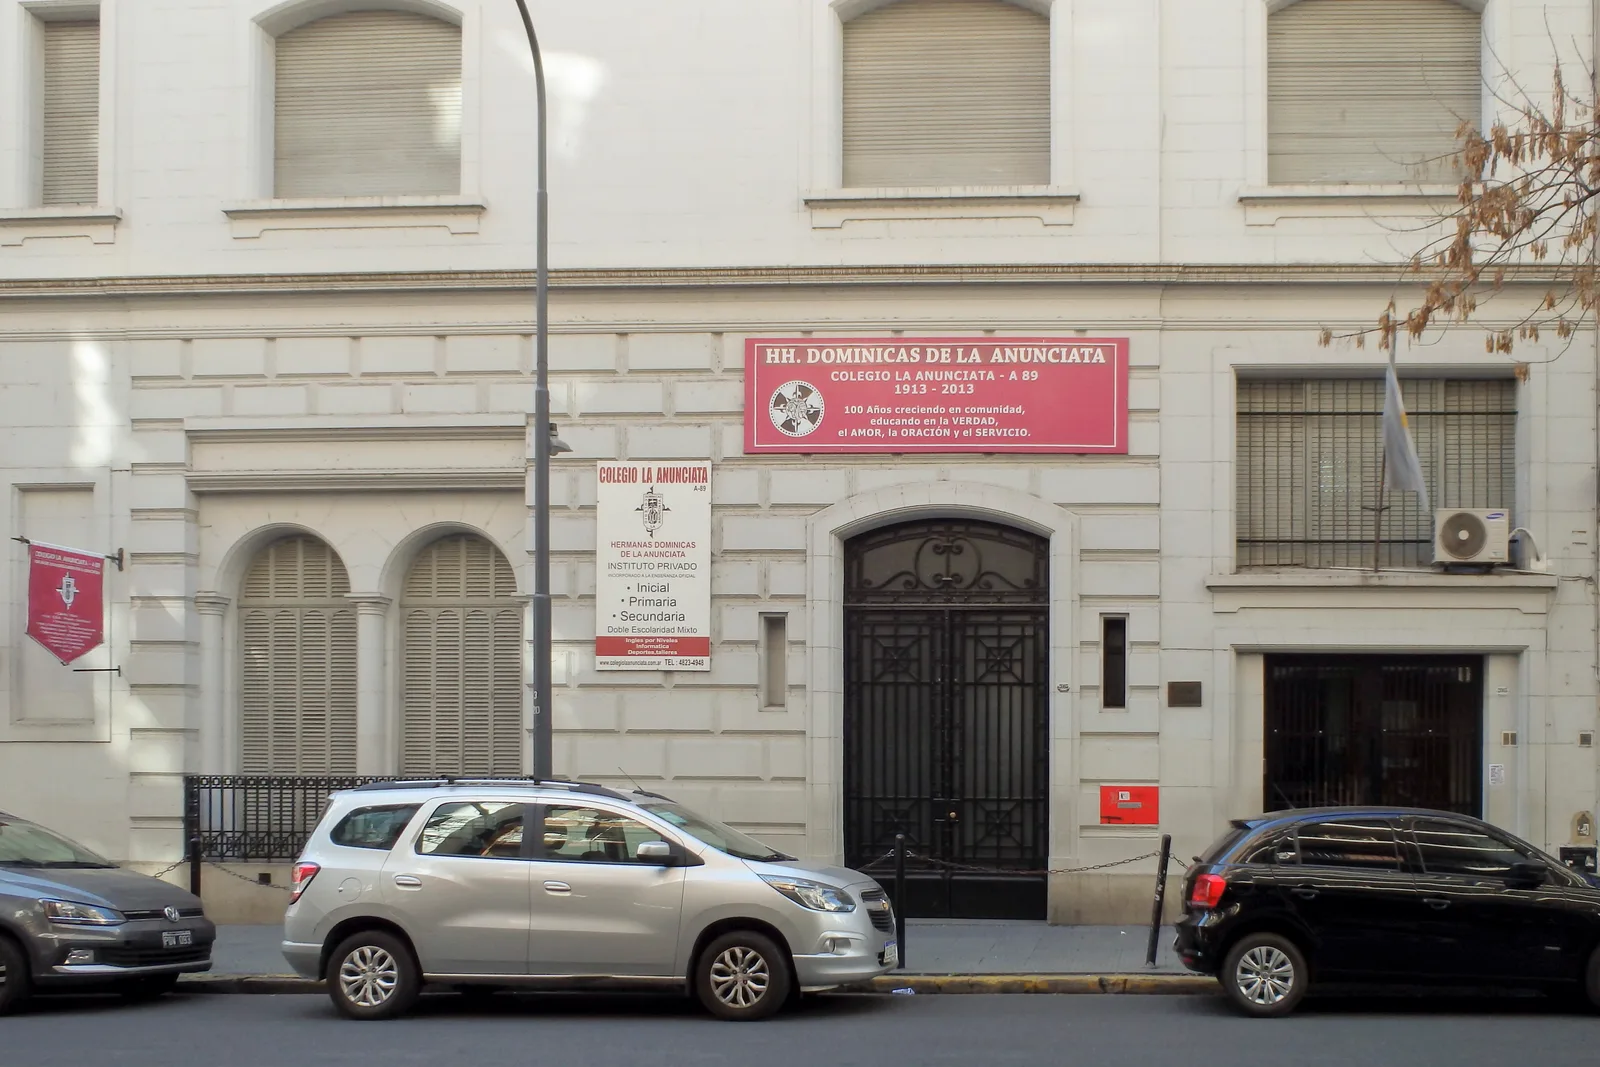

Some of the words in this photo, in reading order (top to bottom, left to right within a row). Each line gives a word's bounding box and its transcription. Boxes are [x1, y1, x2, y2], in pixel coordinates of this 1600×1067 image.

[766, 348, 801, 364] HH.
[806, 348, 920, 364] DOMINICAS
[926, 348, 951, 363] DE
[956, 348, 982, 363] LA
[990, 347, 1106, 363] ANUNCIATA
[831, 371, 891, 381] COLEGIO
[895, 371, 911, 381] LA
[915, 371, 995, 381] ANUNCIATA
[1009, 371, 1018, 381] A
[1022, 370, 1039, 381] 89
[894, 384, 927, 394] 1913
[941, 384, 974, 394] 2013
[844, 405, 864, 414] 100
[866, 405, 892, 414] Años
[895, 405, 946, 414] creciendo
[948, 406, 961, 414] en
[964, 405, 1025, 415] comunidad,
[870, 417, 920, 425] educando
[939, 417, 949, 425] la
[952, 417, 999, 426] VERDAD,
[838, 428, 848, 437] el
[850, 428, 885, 438] AMOR,
[888, 428, 898, 437] la
[901, 426, 951, 437] ORACIÓN
[953, 430, 960, 438] y
[962, 428, 972, 437] el
[975, 428, 1031, 437] SERVICIO.
[599, 466, 638, 484] COLEGIO
[642, 466, 653, 483] LA
[656, 466, 708, 483] ANUNCIATA
[610, 541, 653, 549] HERMANAS
[654, 541, 696, 549] DOMINICAS
[607, 562, 655, 571] INSTITUTO
[657, 562, 697, 571] PRIVADO
[637, 583, 670, 592] Inicial
[629, 596, 677, 607] Primaria
[620, 611, 685, 621] Secundaria
[607, 626, 629, 634] Doble
[631, 626, 675, 634] Escolaridad
[677, 626, 698, 634] Mixto
[665, 658, 675, 666] TEL
